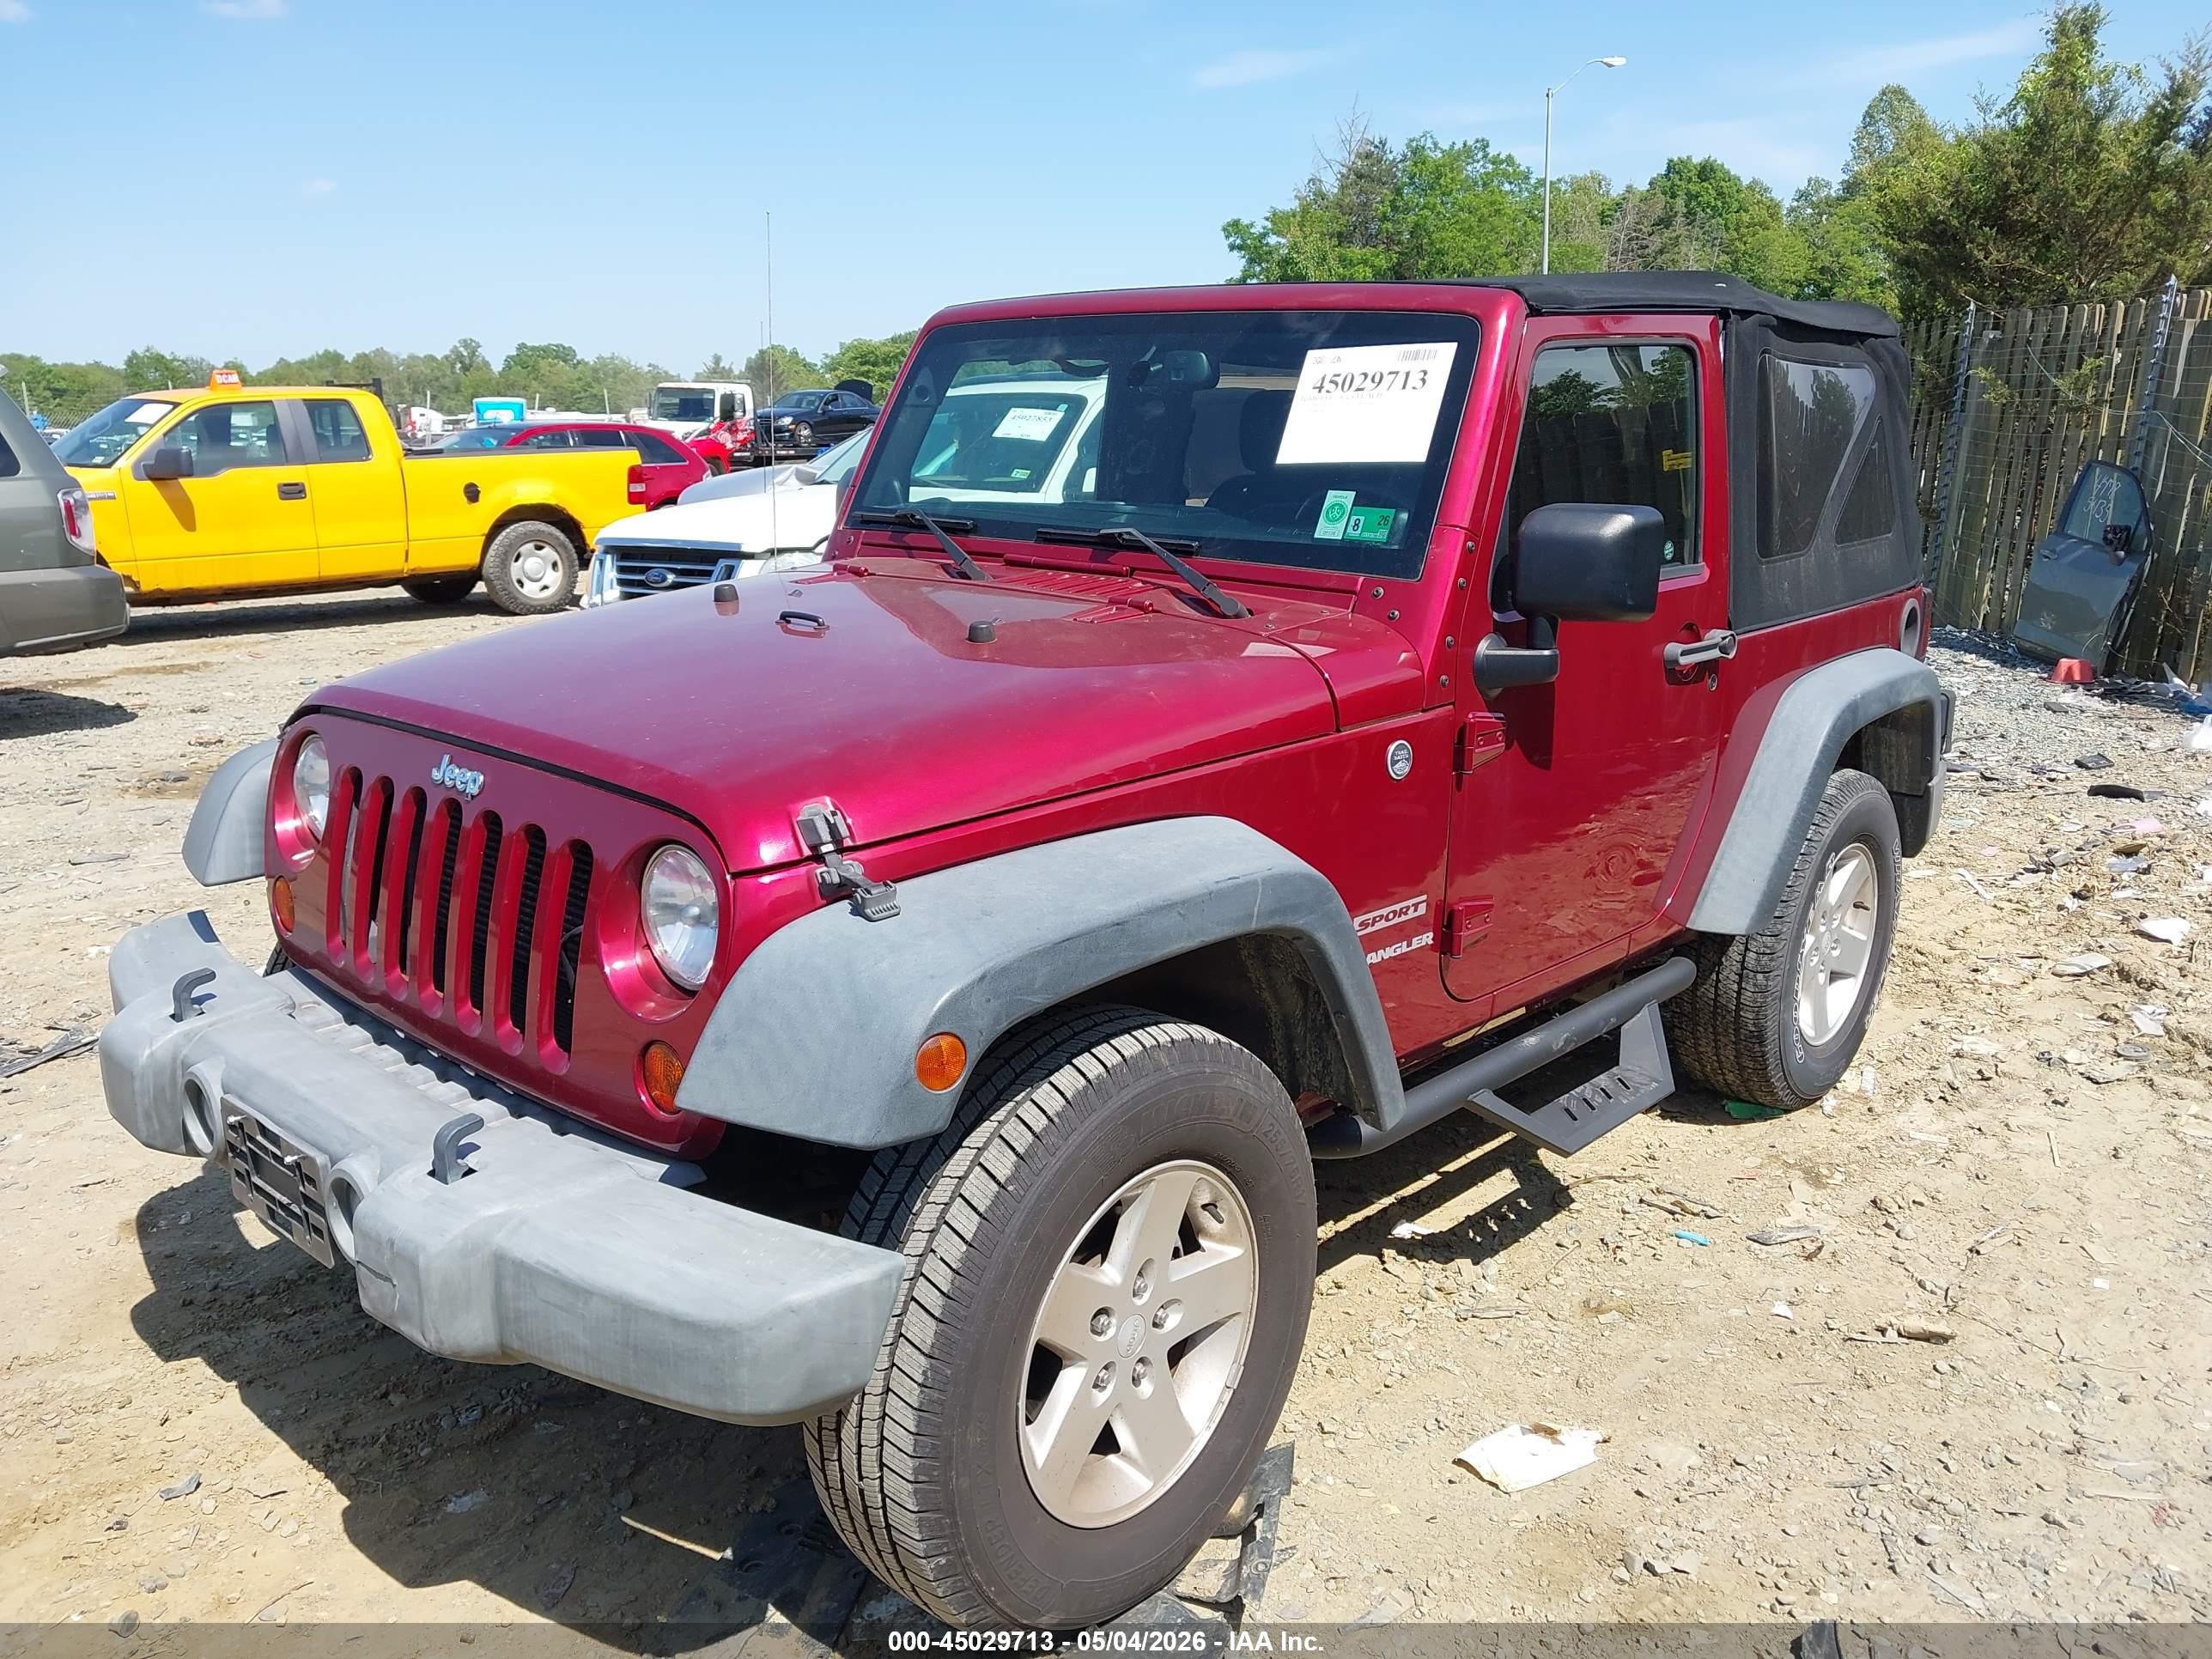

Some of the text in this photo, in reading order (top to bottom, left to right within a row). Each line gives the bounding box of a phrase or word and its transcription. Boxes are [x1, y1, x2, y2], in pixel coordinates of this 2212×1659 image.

[1312, 369, 1428, 393] 45029713
[1351, 518, 1361, 532] 8
[1377, 515, 1390, 526] 26
[432, 754, 484, 797] Jeep
[1358, 900, 1427, 933] SPORT
